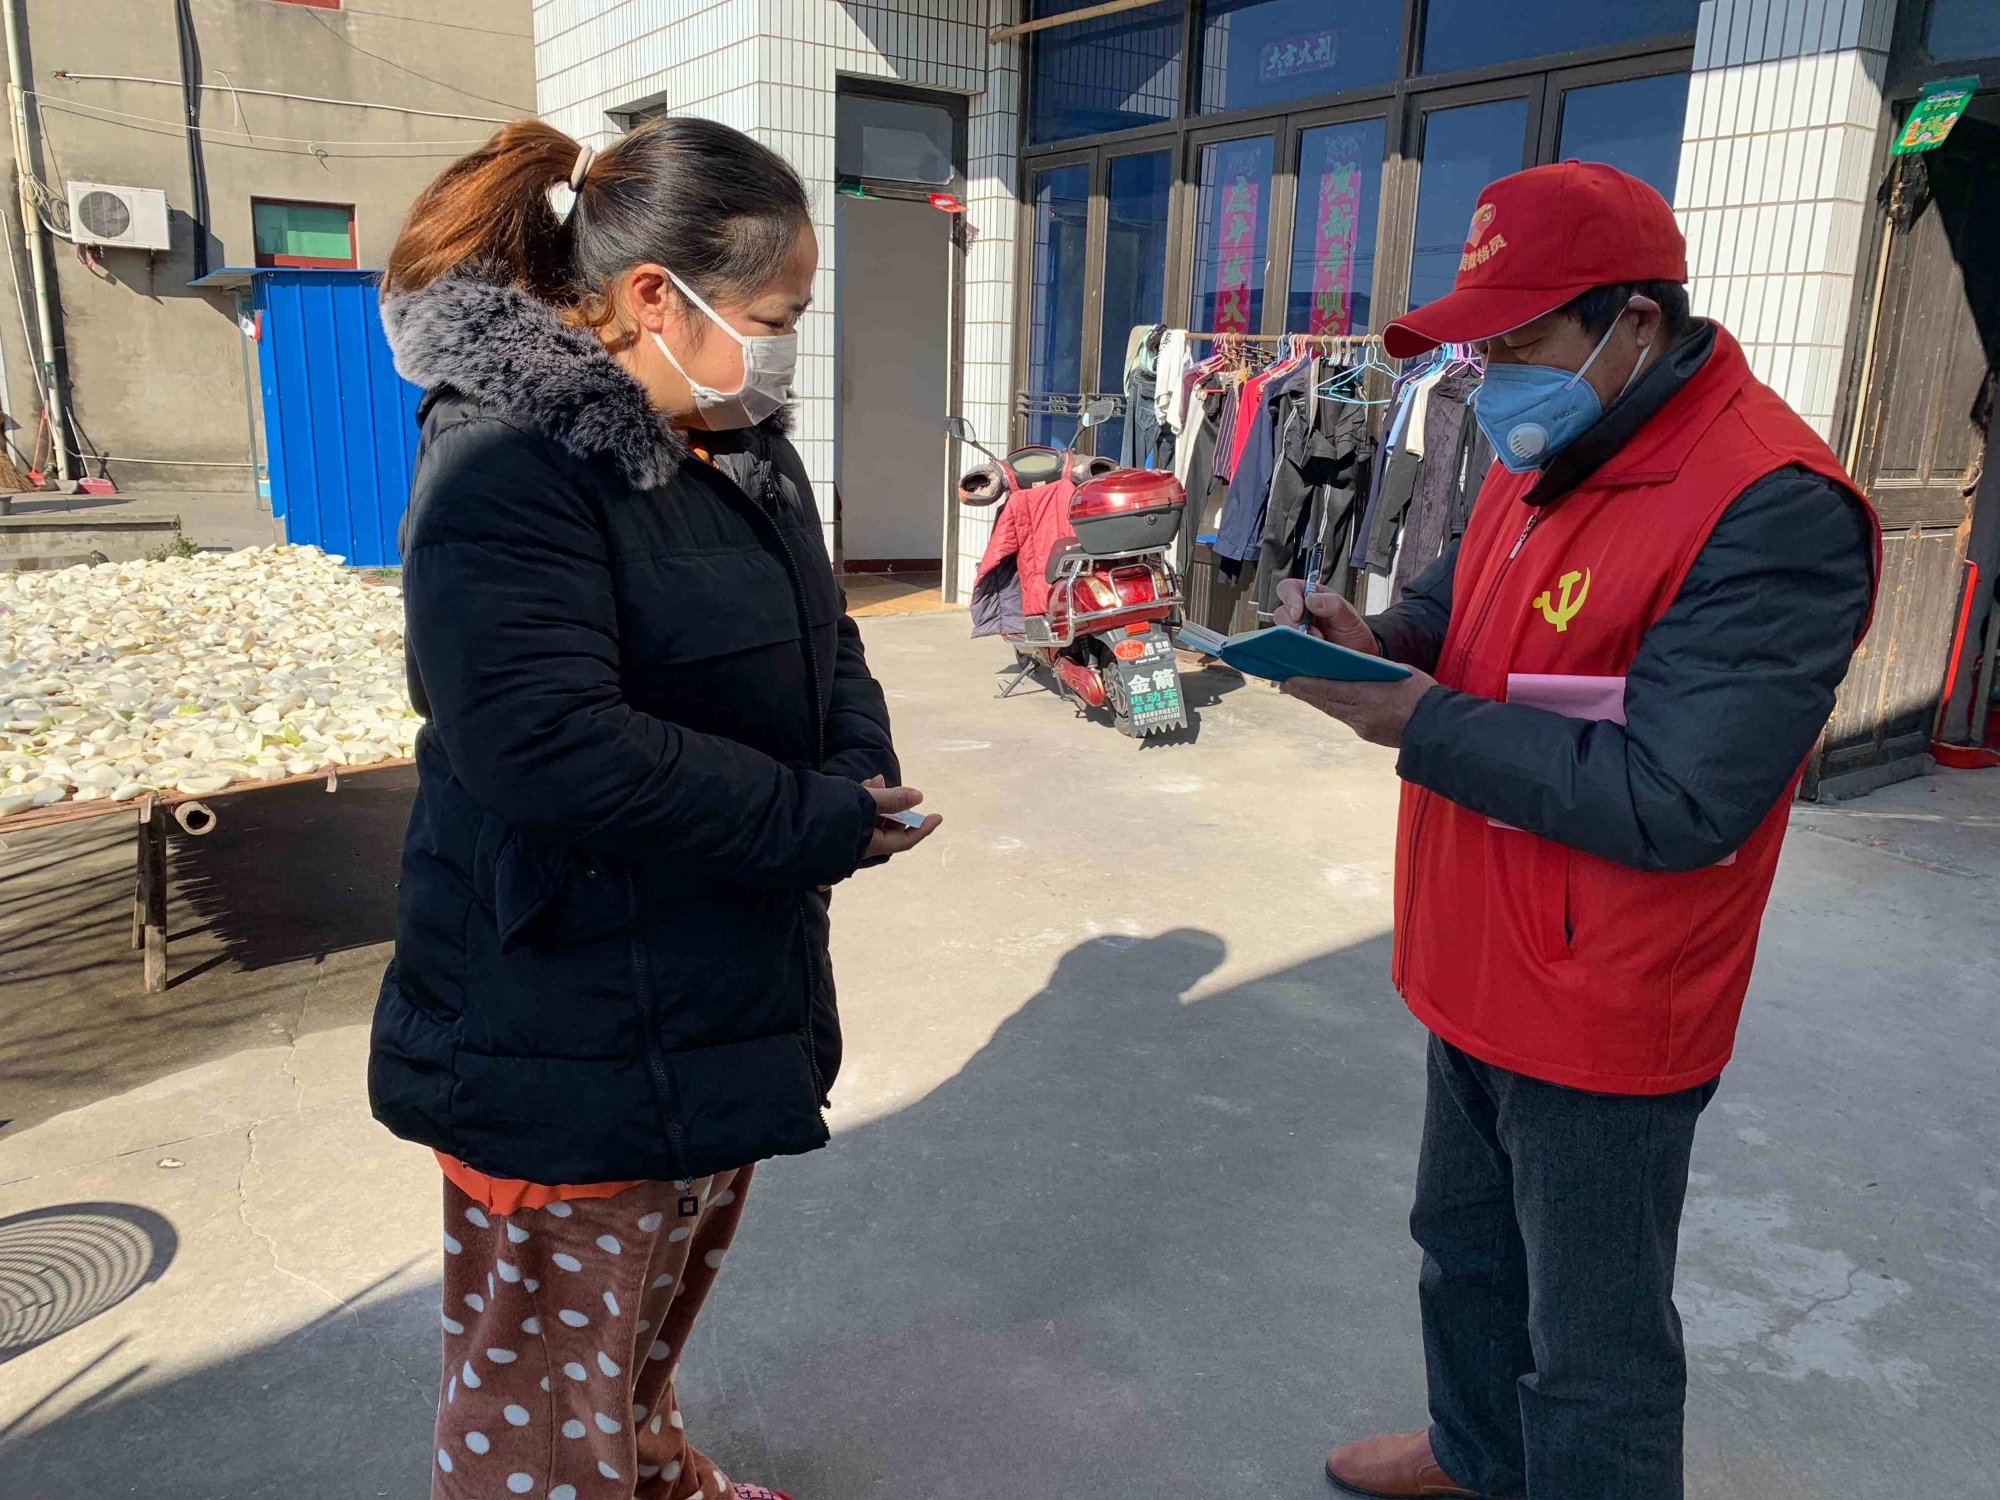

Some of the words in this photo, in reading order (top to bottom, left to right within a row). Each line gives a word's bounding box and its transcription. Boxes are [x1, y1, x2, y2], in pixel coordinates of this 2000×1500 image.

[1127, 668, 1175, 694] 金箭
[1130, 689, 1178, 706] 电动车
